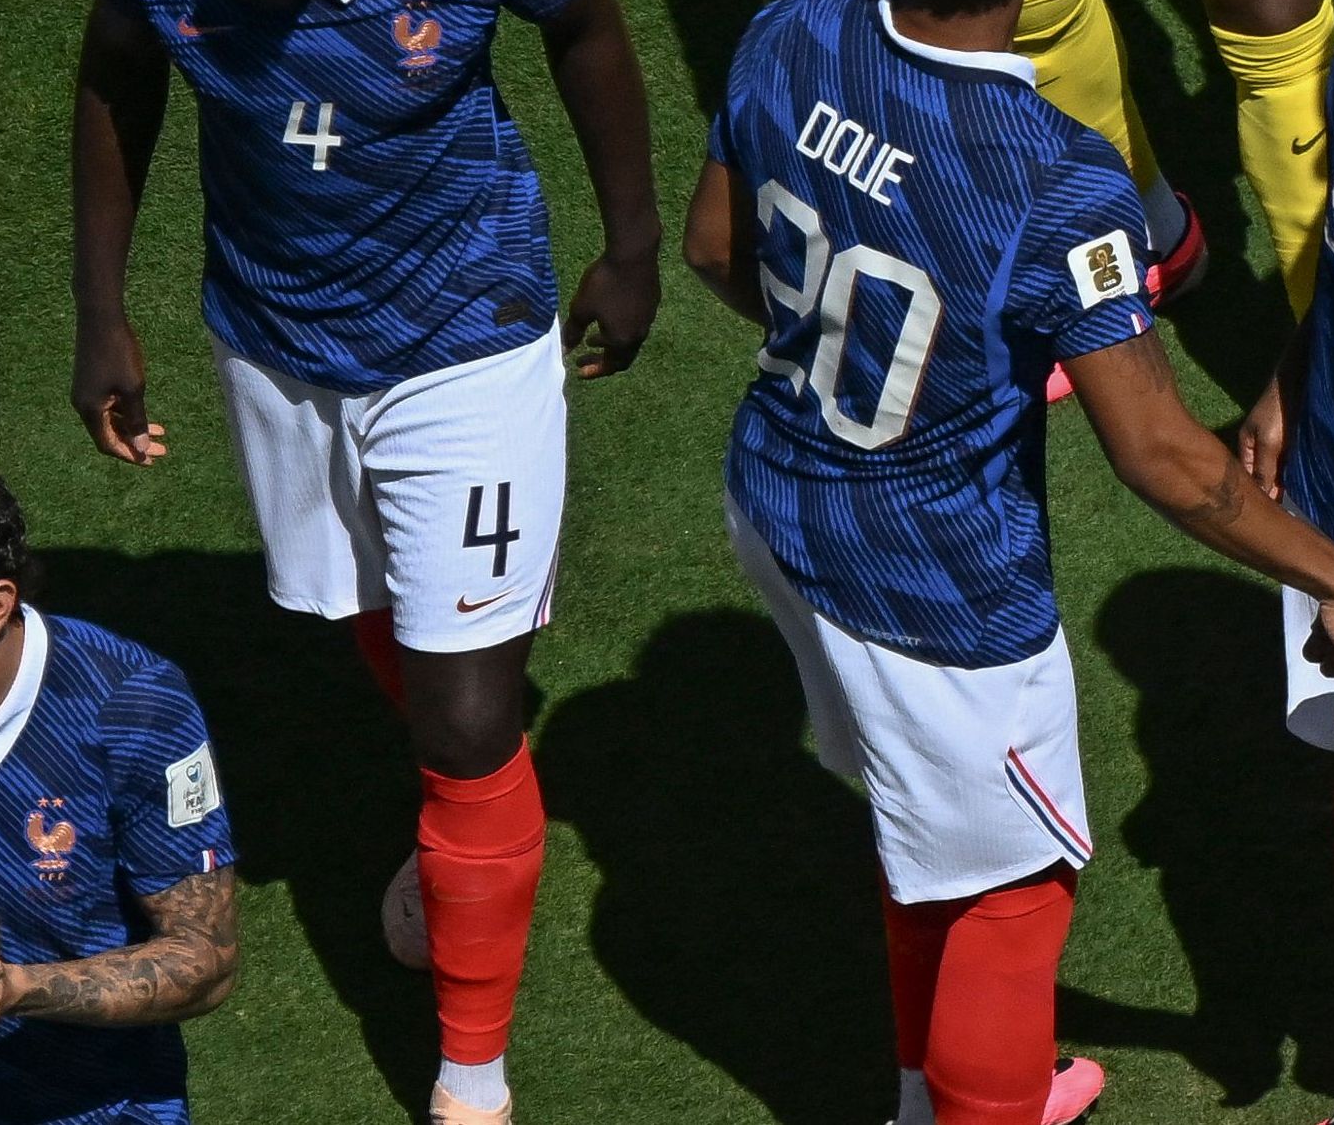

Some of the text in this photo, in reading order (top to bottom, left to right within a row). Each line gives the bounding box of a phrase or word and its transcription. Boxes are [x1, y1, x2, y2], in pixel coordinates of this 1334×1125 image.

[283, 102, 341, 171] 4
[796, 101, 914, 206] DOUE
[757, 179, 943, 450] 20
[462, 481, 521, 578] 4
